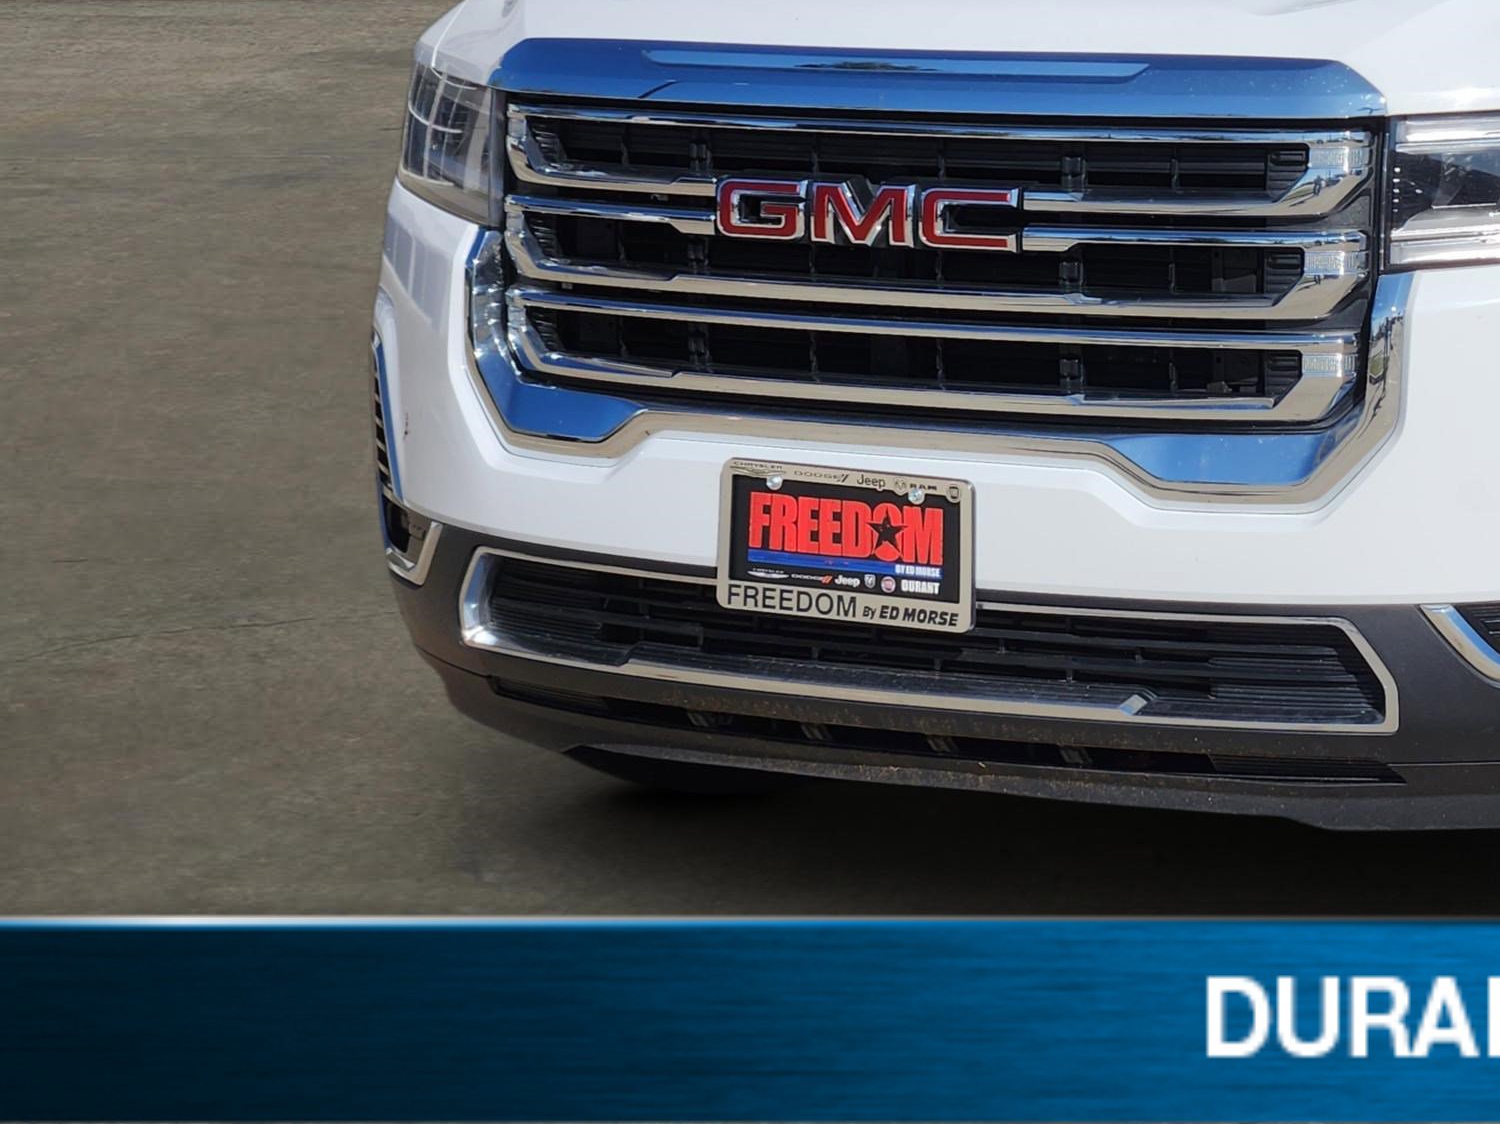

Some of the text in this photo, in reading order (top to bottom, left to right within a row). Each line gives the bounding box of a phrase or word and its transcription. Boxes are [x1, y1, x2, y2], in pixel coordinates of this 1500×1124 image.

[717, 178, 1019, 253] GMC
[857, 474, 886, 489] Jeep
[748, 490, 944, 566] FREEDOM
[834, 575, 861, 588] Jeep
[901, 579, 940, 594] DURANT
[728, 583, 858, 618] FREEDOM
[879, 605, 900, 620] ED
[902, 607, 959, 627] MORSE
